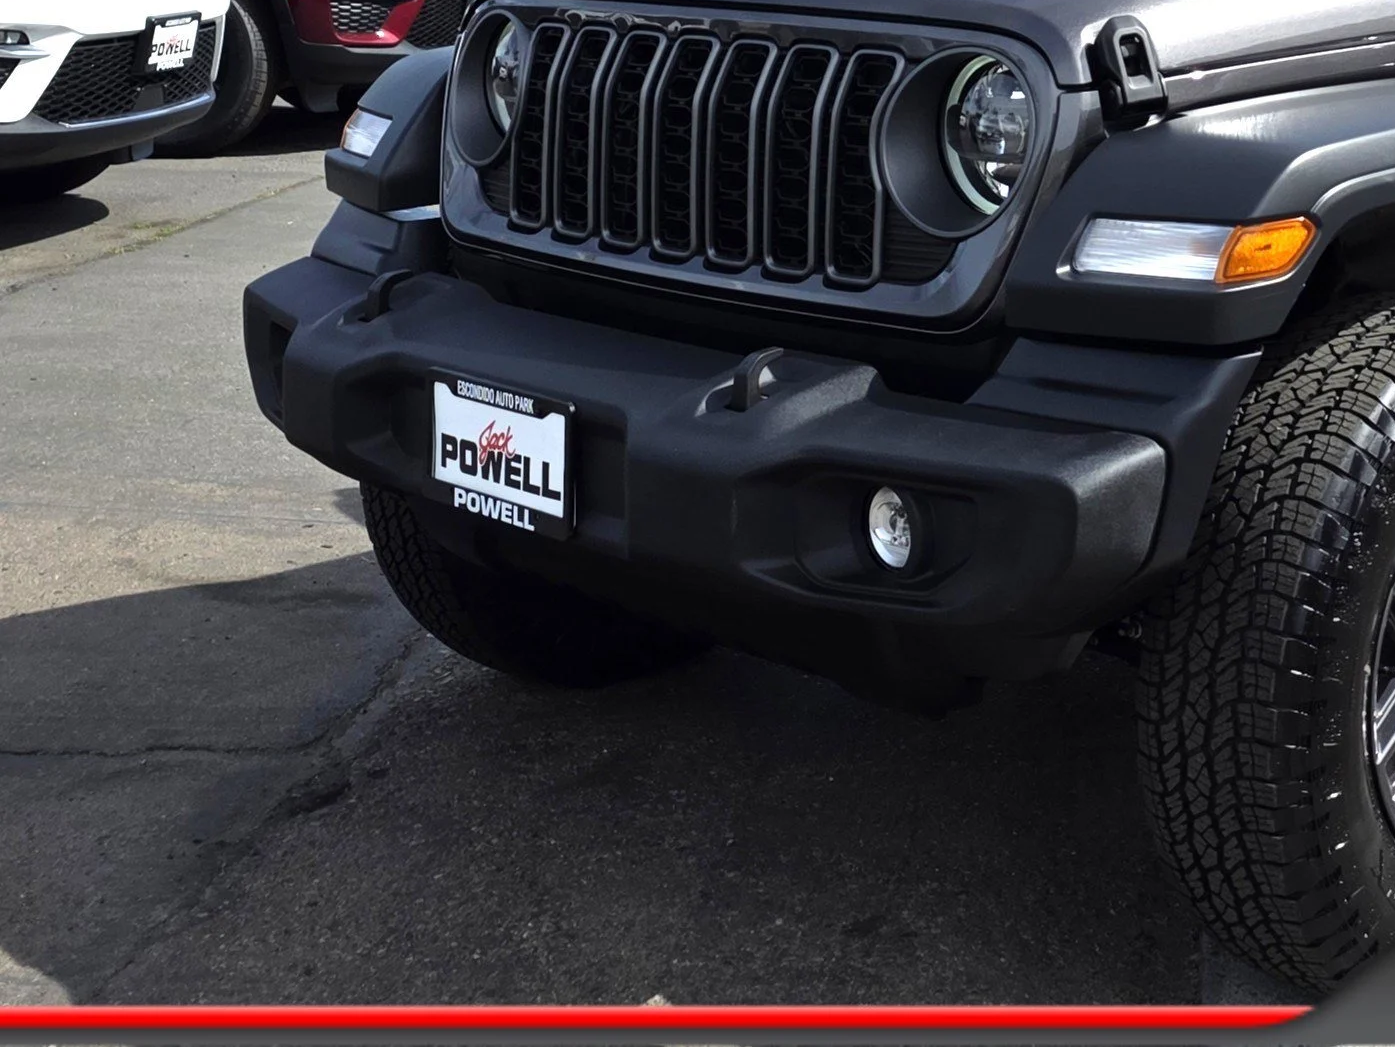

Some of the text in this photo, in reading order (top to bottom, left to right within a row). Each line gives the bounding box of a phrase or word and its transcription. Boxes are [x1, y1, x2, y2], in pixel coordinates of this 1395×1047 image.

[457, 379, 534, 414] ESCONDIDO AUTO PARK
[478, 420, 516, 467] Jack
[441, 432, 562, 502] POWELL
[453, 487, 535, 532] POWELL
